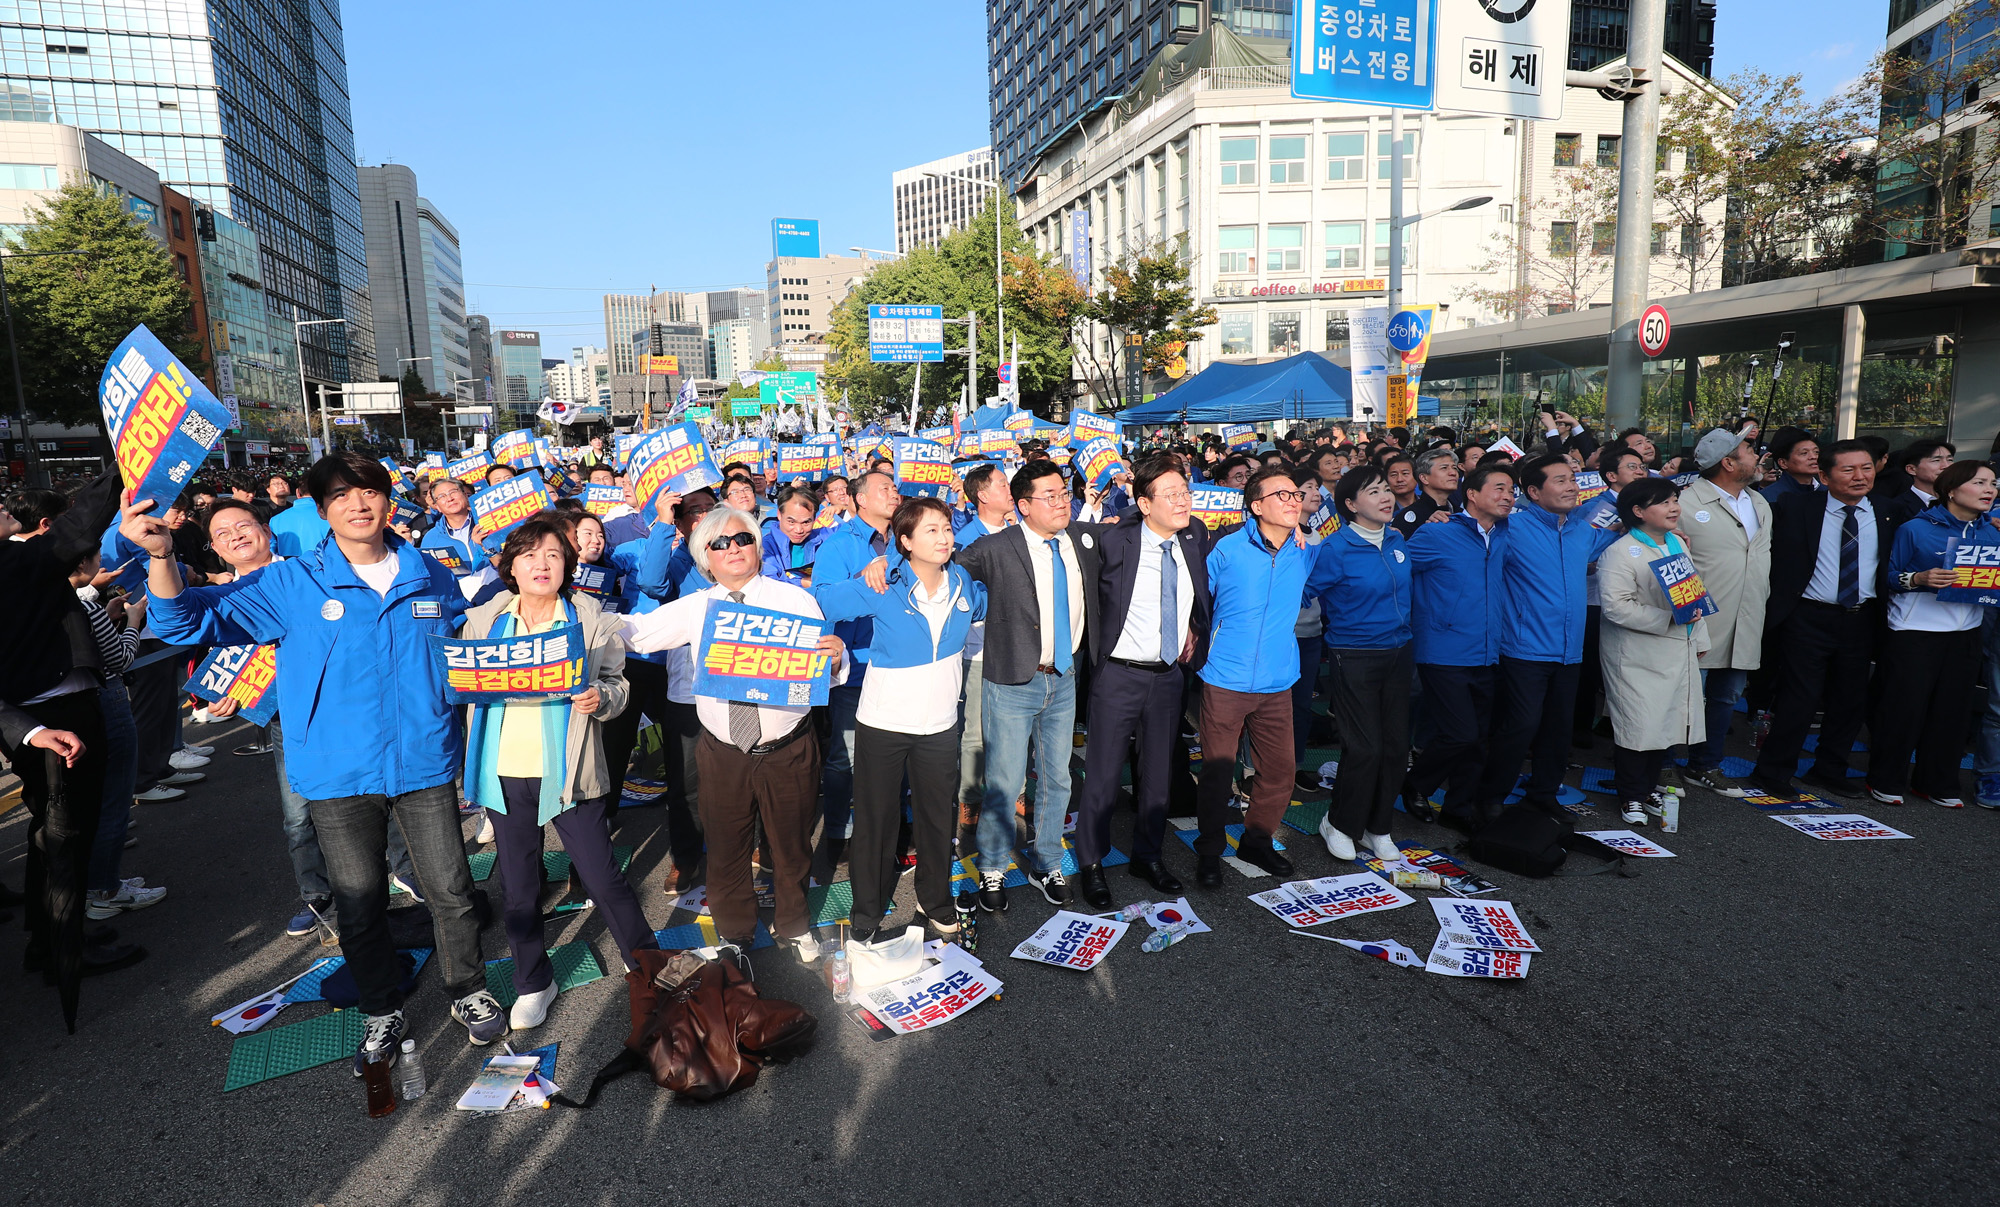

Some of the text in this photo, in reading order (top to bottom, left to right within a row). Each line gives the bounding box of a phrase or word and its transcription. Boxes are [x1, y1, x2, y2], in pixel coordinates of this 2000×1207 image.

[1319, 5, 1412, 42] 중앙차로
[1318, 45, 1411, 82] 버스전용
[1251, 283, 1297, 296] coffee
[1300, 282, 1309, 294] &
[1313, 282, 1340, 293] HOF
[889, 307, 932, 316] 차량운행제한
[1646, 318, 1664, 344] 50
[1134, 350, 1139, 358] 4
[101, 346, 153, 461] 건희를
[980, 431, 1012, 440] 김건희를
[1076, 413, 1116, 433] 김건희를
[1225, 425, 1253, 437] 김건희를
[629, 428, 689, 488] 김건희를
[726, 441, 759, 459] 김건희를
[780, 458, 828, 472] 특검하라!
[781, 446, 825, 459] 김건희를
[1085, 450, 1121, 480] 특검하
[635, 443, 705, 509] 특검하라!
[473, 478, 535, 517] 김건희를
[588, 488, 626, 501] 김건희
[478, 490, 548, 532] 특검하라!
[1308, 505, 1331, 529] 희를
[1659, 556, 1695, 586] 김건희를
[713, 611, 822, 649] 김건희를
[444, 635, 569, 668] 김건희를
[704, 643, 828, 679] 특검하라!
[200, 644, 254, 695] 김건
[447, 657, 584, 691] 특검하라!
[1814, 829, 1897, 840] 국정농단
[1302, 882, 1386, 909] 진상규명!
[1319, 893, 1400, 915] 국정농단
[1484, 906, 1535, 949] 국정농단
[1067, 926, 1116, 968] 국정농단
[878, 969, 974, 1020] 진상규명!
[896, 981, 987, 1031] 국정농단
